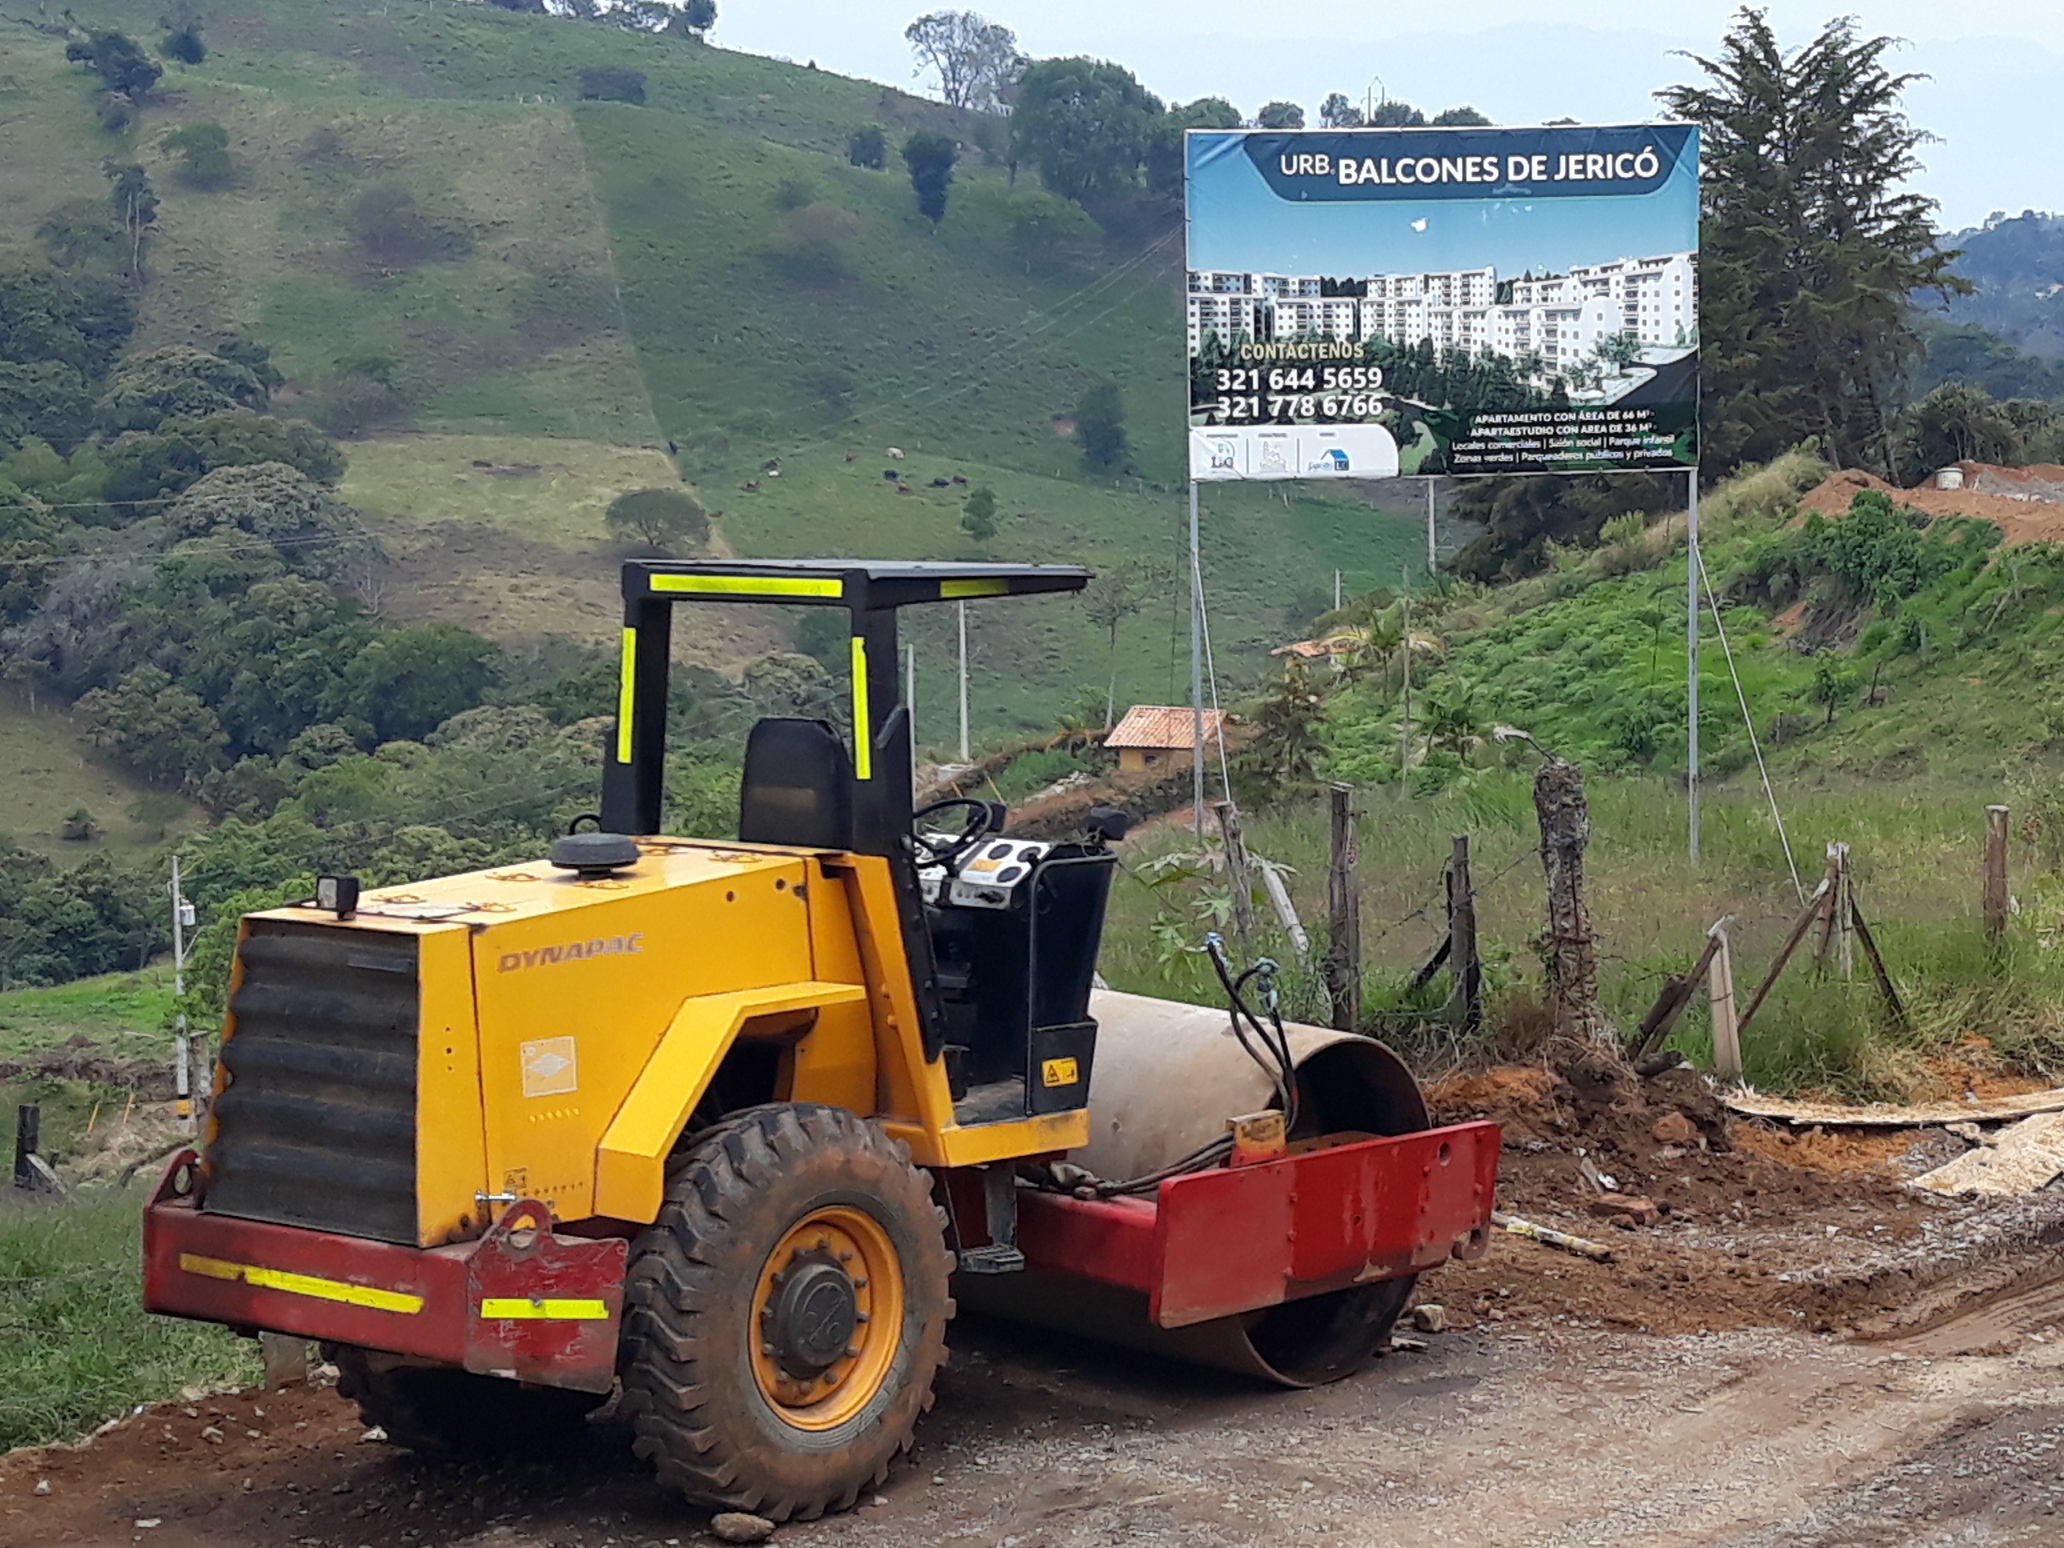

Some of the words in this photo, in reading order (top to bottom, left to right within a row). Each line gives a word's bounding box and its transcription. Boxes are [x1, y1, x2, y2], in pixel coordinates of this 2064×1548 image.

[1281, 154, 1336, 175] URB.
[1338, 156, 1499, 184] BALCONES
[1507, 155, 1547, 181] DE
[1554, 146, 1659, 180] JERICÓ
[1241, 343, 1364, 360] CONTACTENOS
[1217, 369, 1259, 390] 321
[1269, 369, 1315, 390] 644
[1323, 367, 1383, 389] 5659
[1218, 397, 1259, 418] 321
[1268, 396, 1315, 417] 778
[1323, 396, 1383, 416] 6766
[1474, 413, 1552, 424] APARTAMENTO
[1554, 413, 1576, 421] CON
[1606, 411, 1620, 420] DE
[1470, 426, 1554, 437] APARTAESTUDIO
[1556, 425, 1579, 435] CON
[1608, 424, 1623, 433] DE
[1625, 451, 1632, 460] y
[497, 932, 643, 973] DYNAPAC
